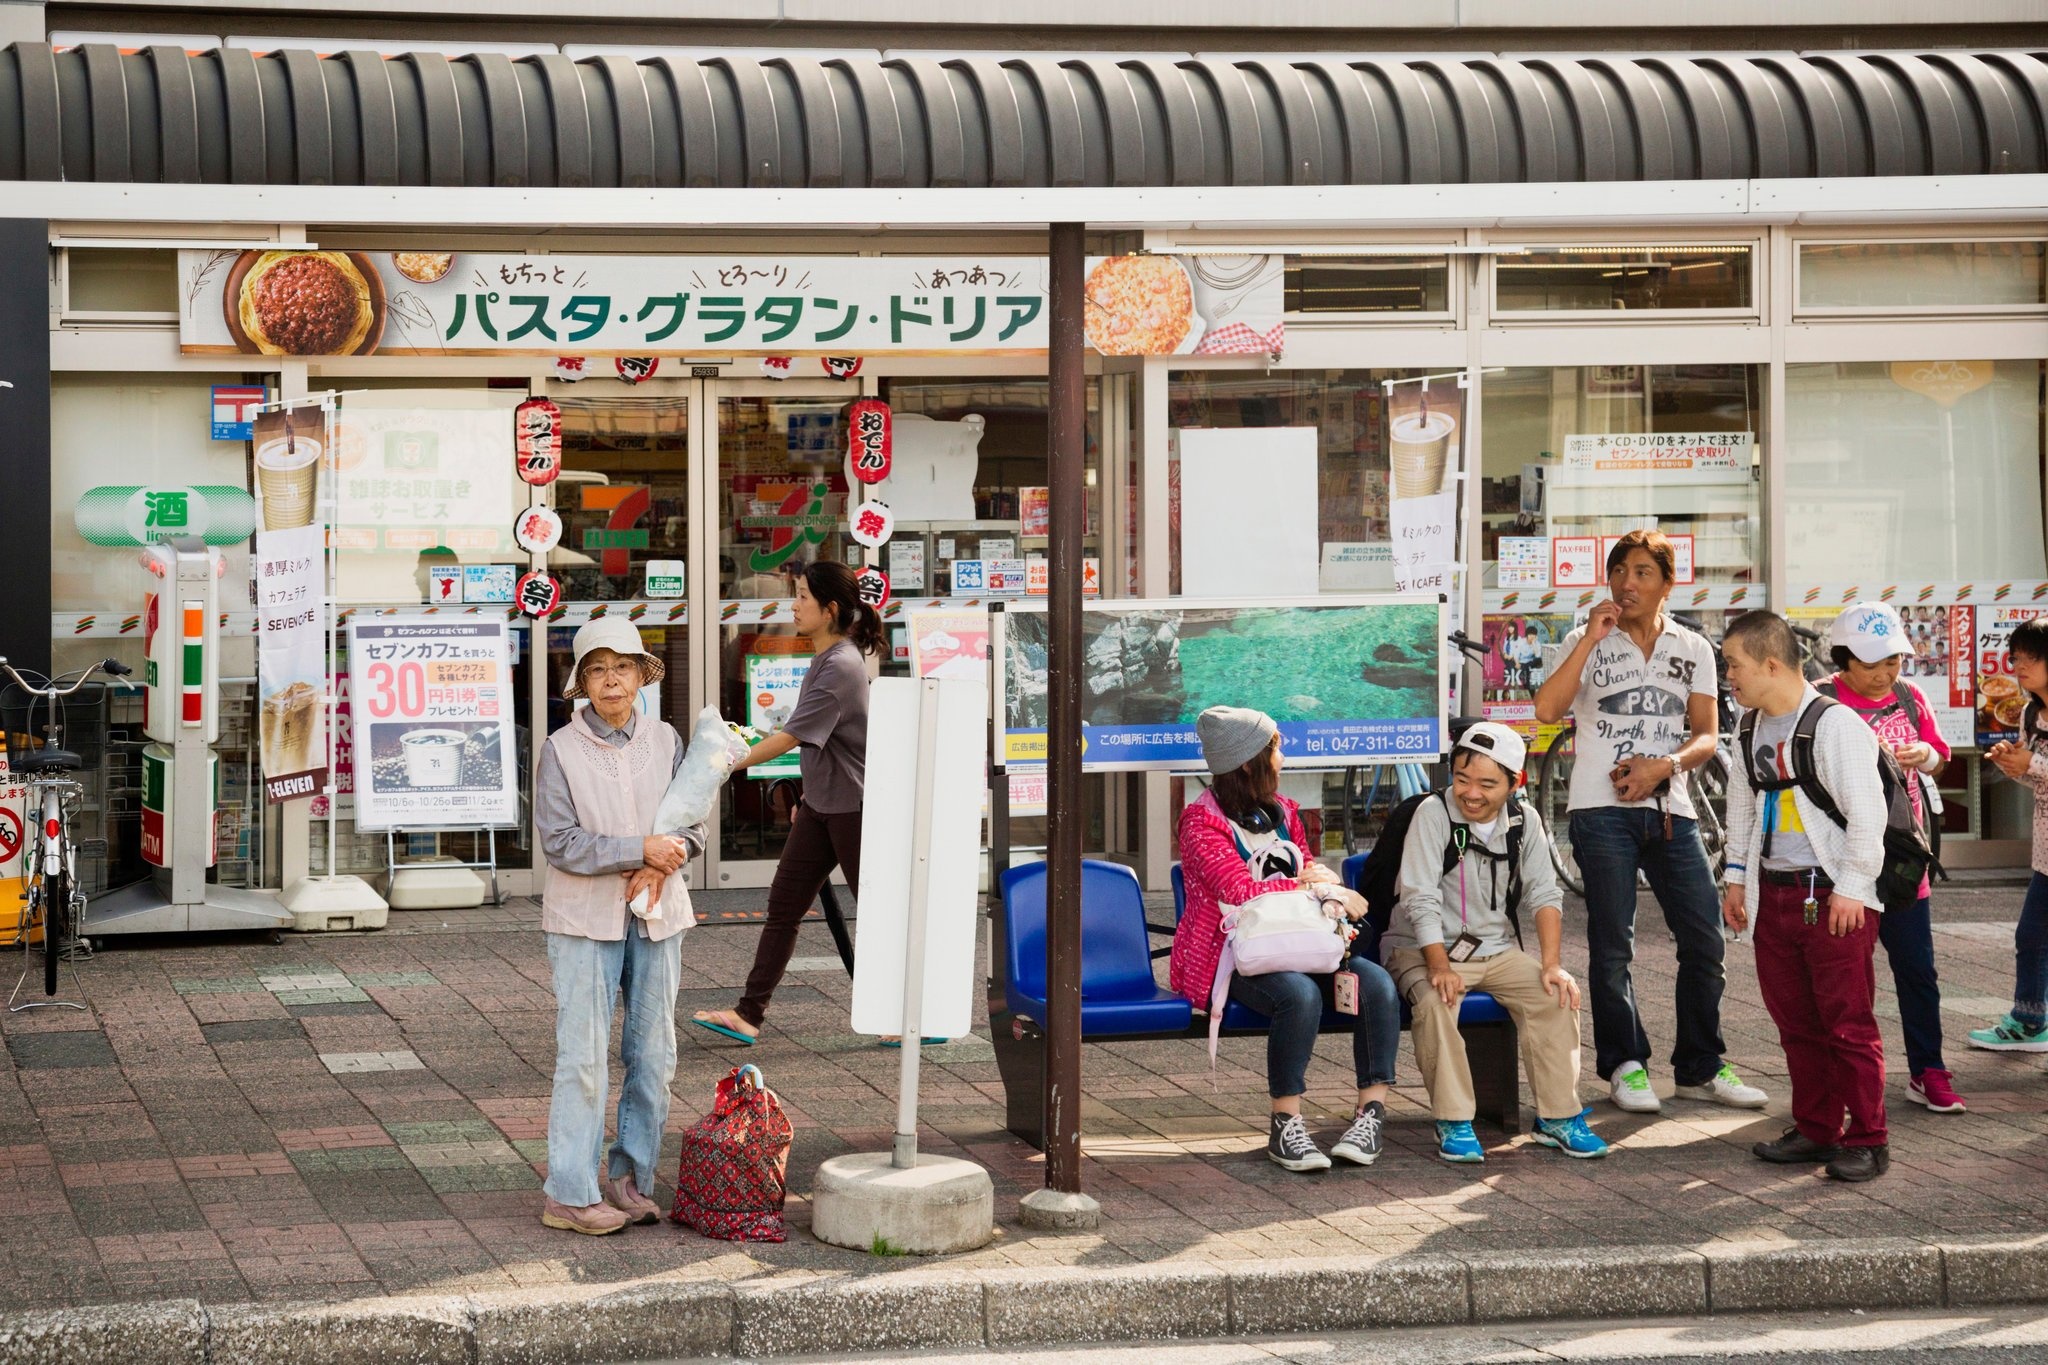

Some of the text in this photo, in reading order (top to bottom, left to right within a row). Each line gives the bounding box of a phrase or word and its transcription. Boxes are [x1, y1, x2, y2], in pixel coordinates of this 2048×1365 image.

[500, 262, 565, 285] もちっと
[931, 265, 1006, 289] あつあつ
[446, 291, 1042, 343] パスタ・グラタン・ドリア
[693, 368, 717, 376] 259331
[860, 412, 885, 470] おでん
[145, 491, 188, 528] 酒
[1417, 573, 1442, 589] CAFÉ
[522, 580, 553, 609] 祭
[366, 643, 495, 660] セブンカフェ を買うと
[1956, 606, 1971, 706] スタッフ募集!
[436, 664, 486, 673] セブンカフェ
[438, 672, 486, 681] 各種Lサイズ
[368, 661, 426, 718] 30
[428, 688, 476, 704] 円引券
[428, 705, 477, 717] プレゼント!
[1627, 690, 1669, 715] P&Y
[1597, 719, 1646, 740] North
[1307, 735, 1430, 751] tel. 047-311-6231
